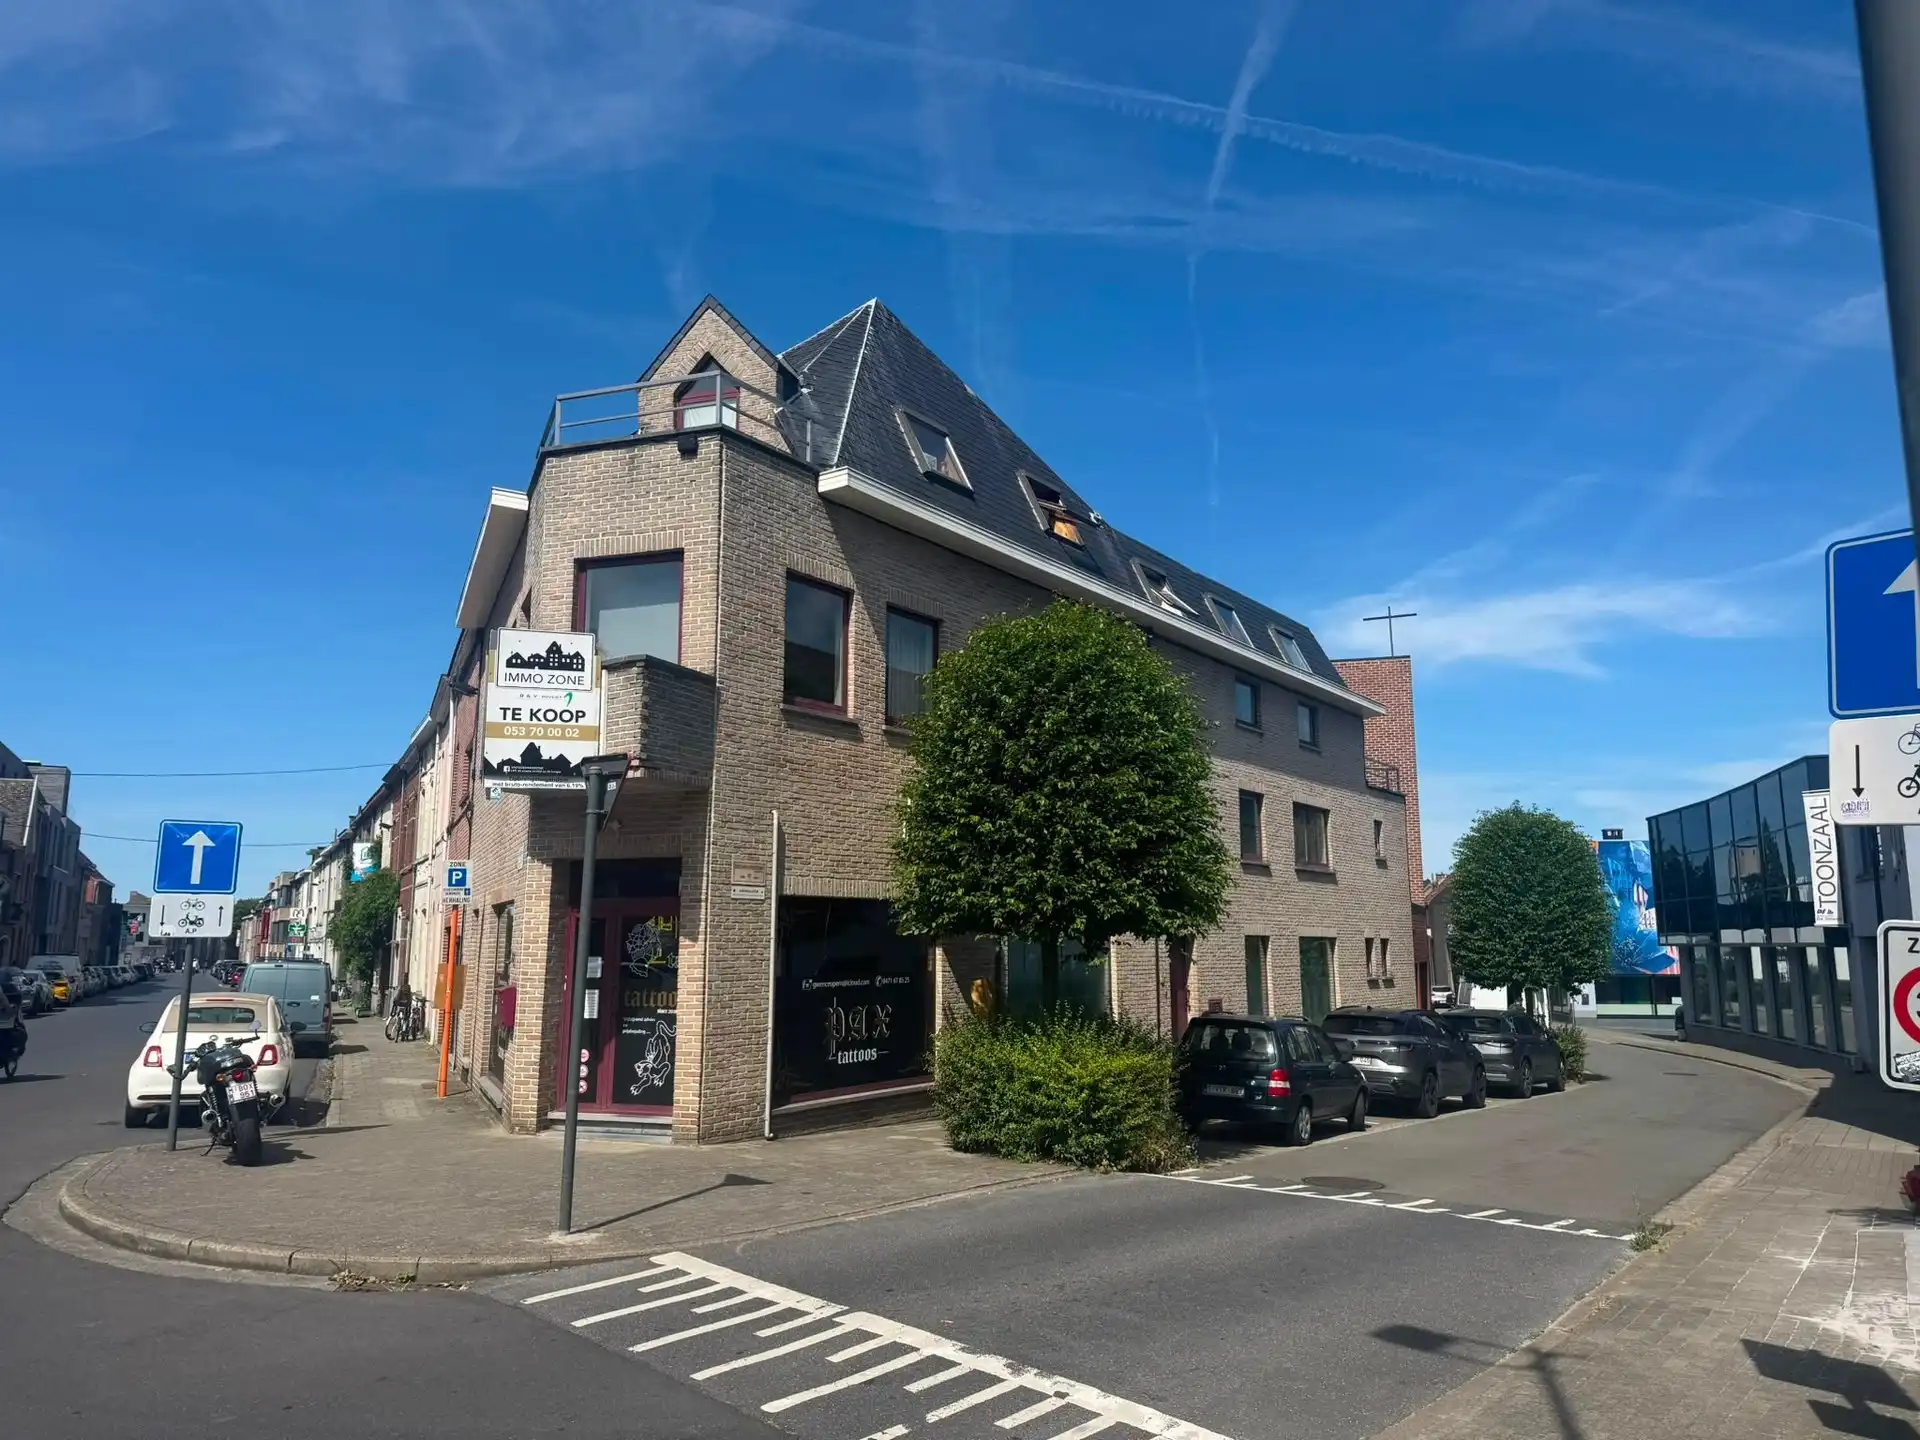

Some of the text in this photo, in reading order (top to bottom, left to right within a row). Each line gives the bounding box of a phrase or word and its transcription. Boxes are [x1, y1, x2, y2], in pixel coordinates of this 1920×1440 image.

[504, 672, 585, 686] IMMO ZONE
[499, 706, 586, 723] TE KOOP
[503, 725, 580, 738] 053 70 00 02
[1809, 798, 1837, 908] TOONZAAL
[452, 871, 463, 885] P
[837, 1047, 878, 1064] tattoos
